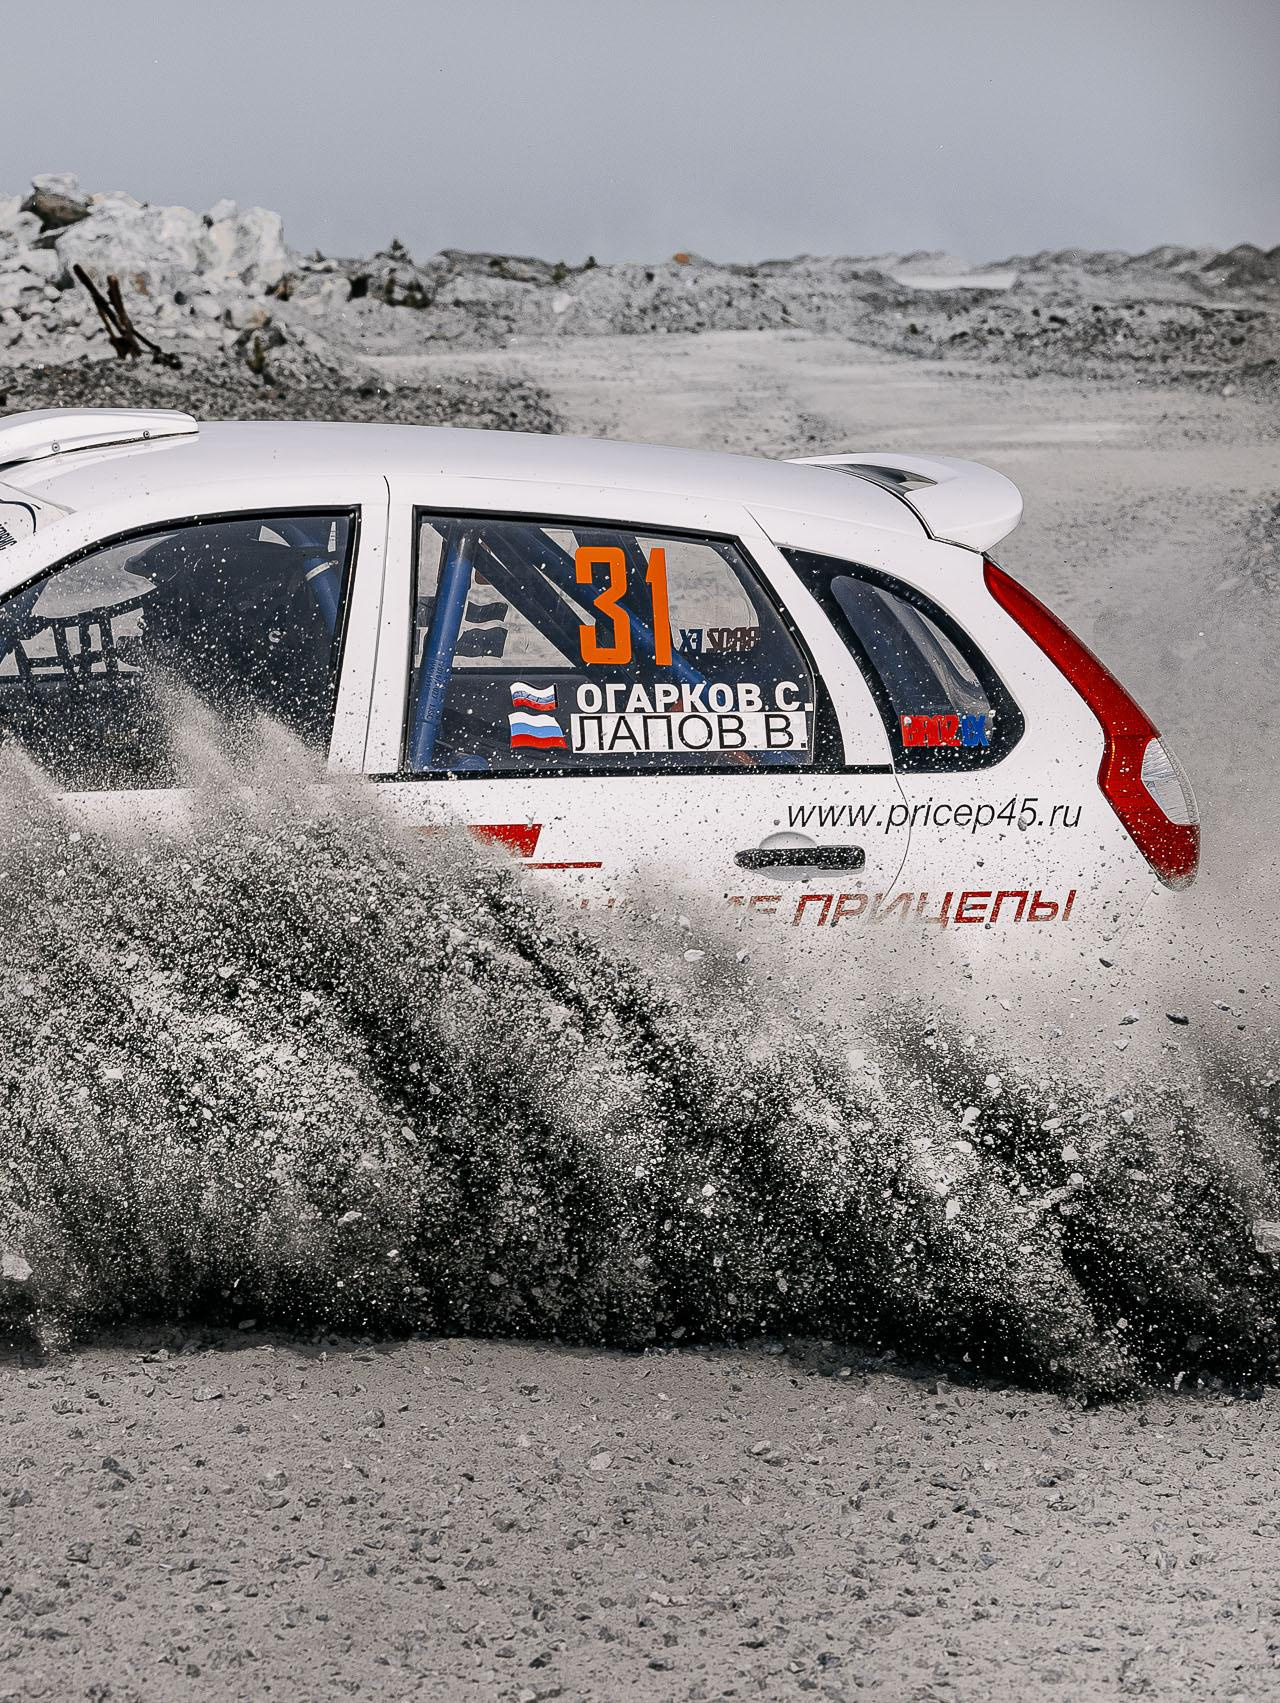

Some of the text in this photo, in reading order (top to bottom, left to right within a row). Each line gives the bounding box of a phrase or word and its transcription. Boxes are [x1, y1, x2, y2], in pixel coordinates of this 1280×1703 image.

[575, 547, 672, 665] 31
[576, 681, 763, 713] ОГАРКОВ
[575, 714, 747, 751] ЛАПОВ
[787, 797, 1082, 834] www.pricep45.ru
[792, 889, 1078, 928] ПРИЦЕПЫ
